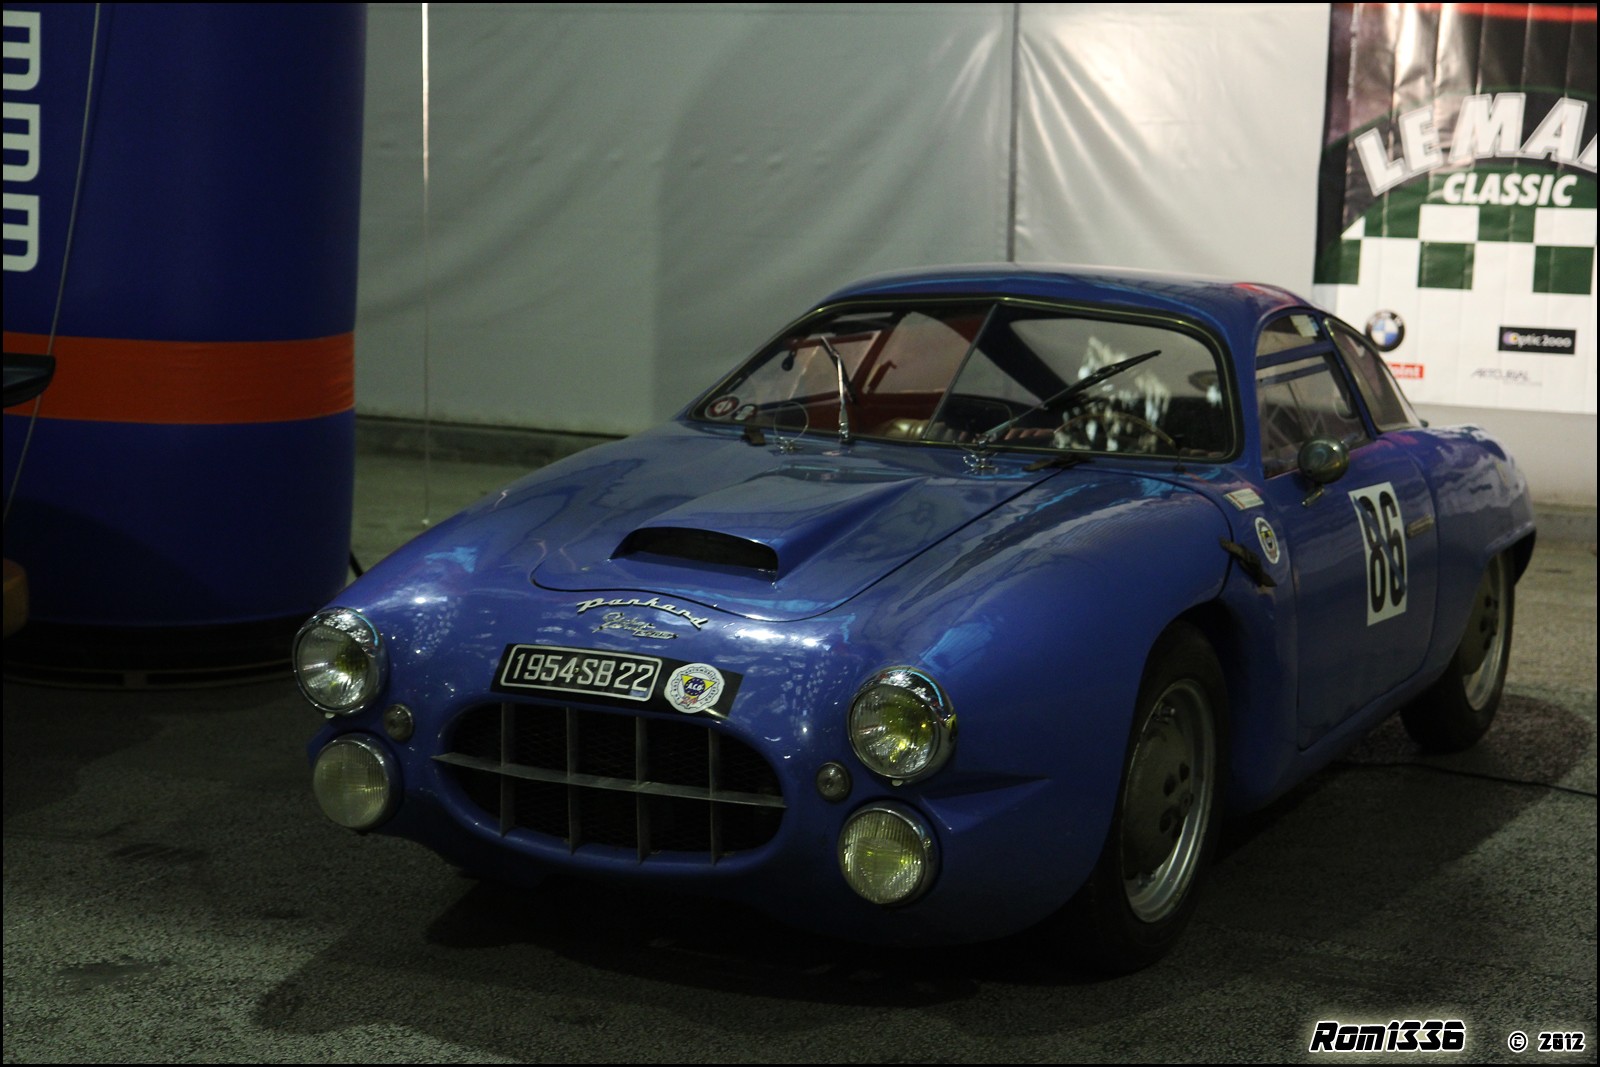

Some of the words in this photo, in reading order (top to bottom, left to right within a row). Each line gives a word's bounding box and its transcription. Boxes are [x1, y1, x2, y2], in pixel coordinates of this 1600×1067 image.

[1354, 105, 1444, 197] LE
[1443, 172, 1578, 206] CLASSIC
[1359, 490, 1406, 613] 86
